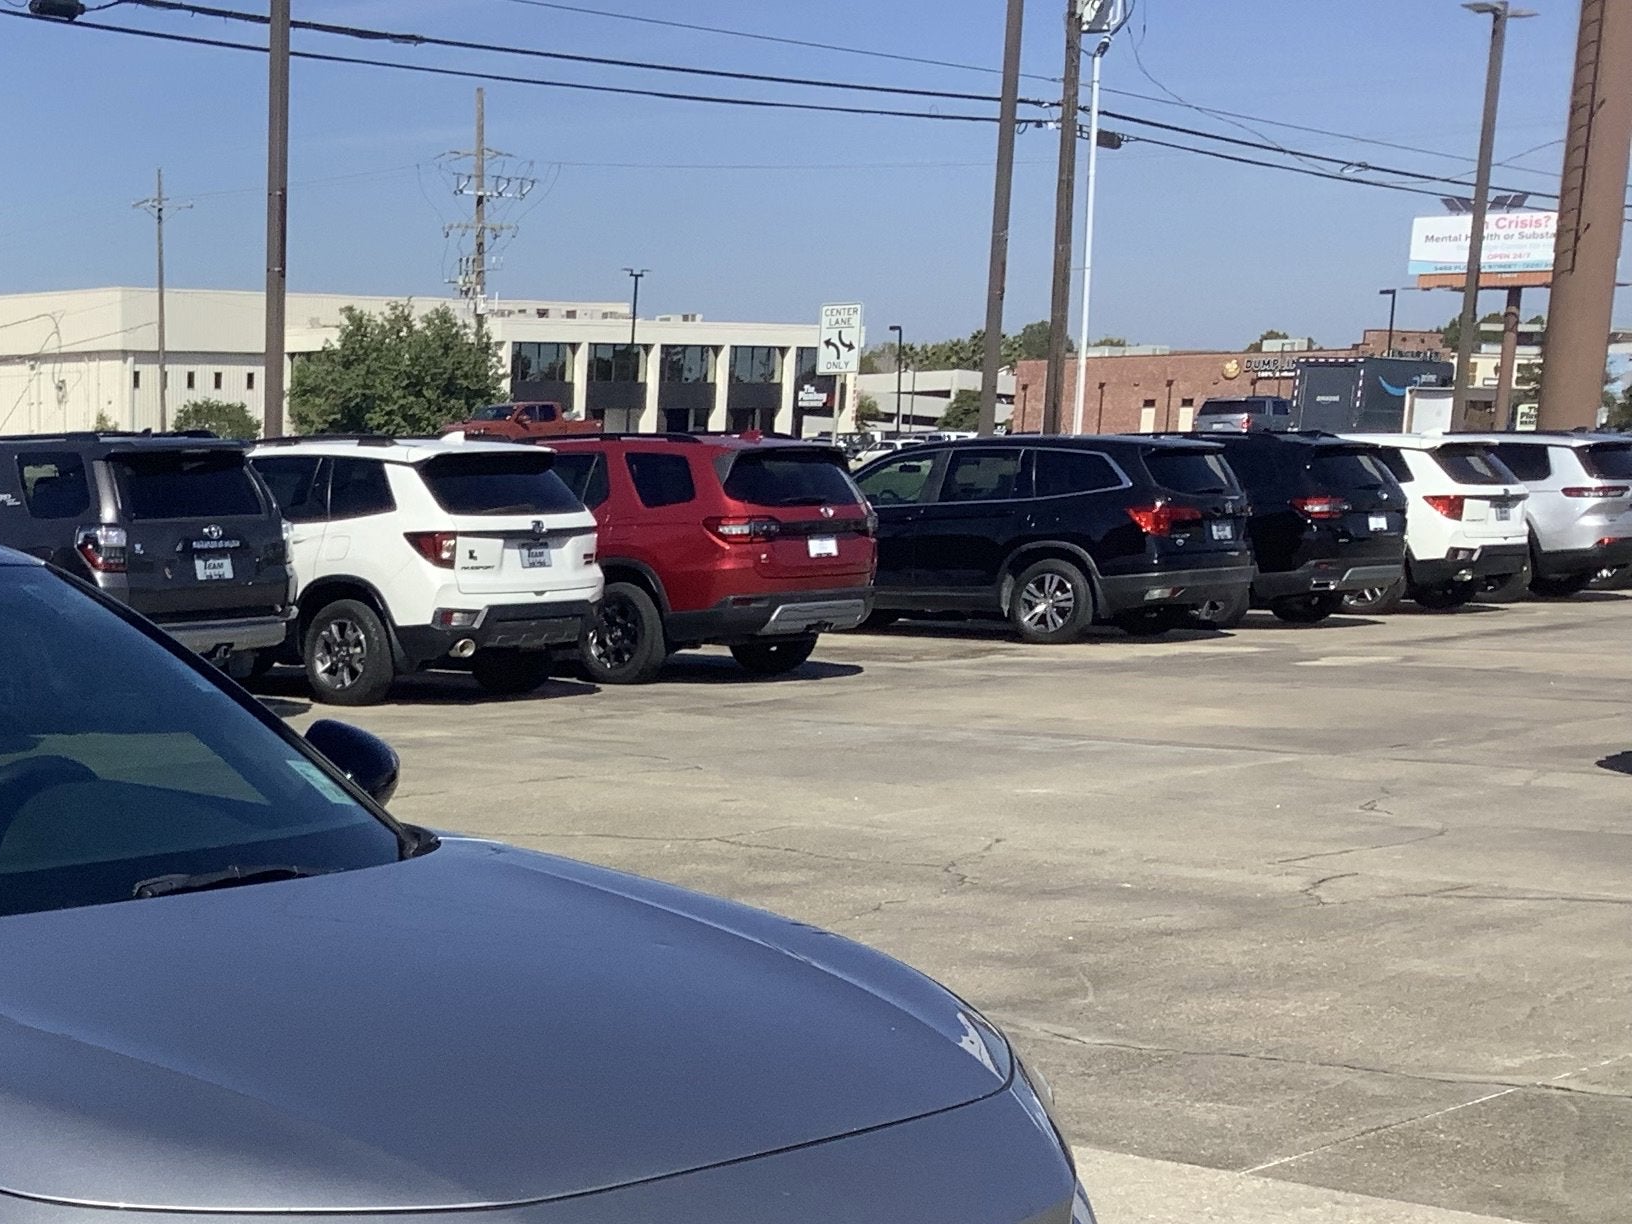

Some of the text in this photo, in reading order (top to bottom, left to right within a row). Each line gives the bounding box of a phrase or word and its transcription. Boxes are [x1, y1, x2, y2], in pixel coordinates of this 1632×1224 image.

[1495, 216, 1551, 230] Crisis?
[1424, 232, 1462, 243] Mental
[1464, 230, 1501, 241] Hlth
[824, 307, 858, 317] CENTER
[829, 318, 853, 327] LANE
[826, 361, 850, 370] ONLY
